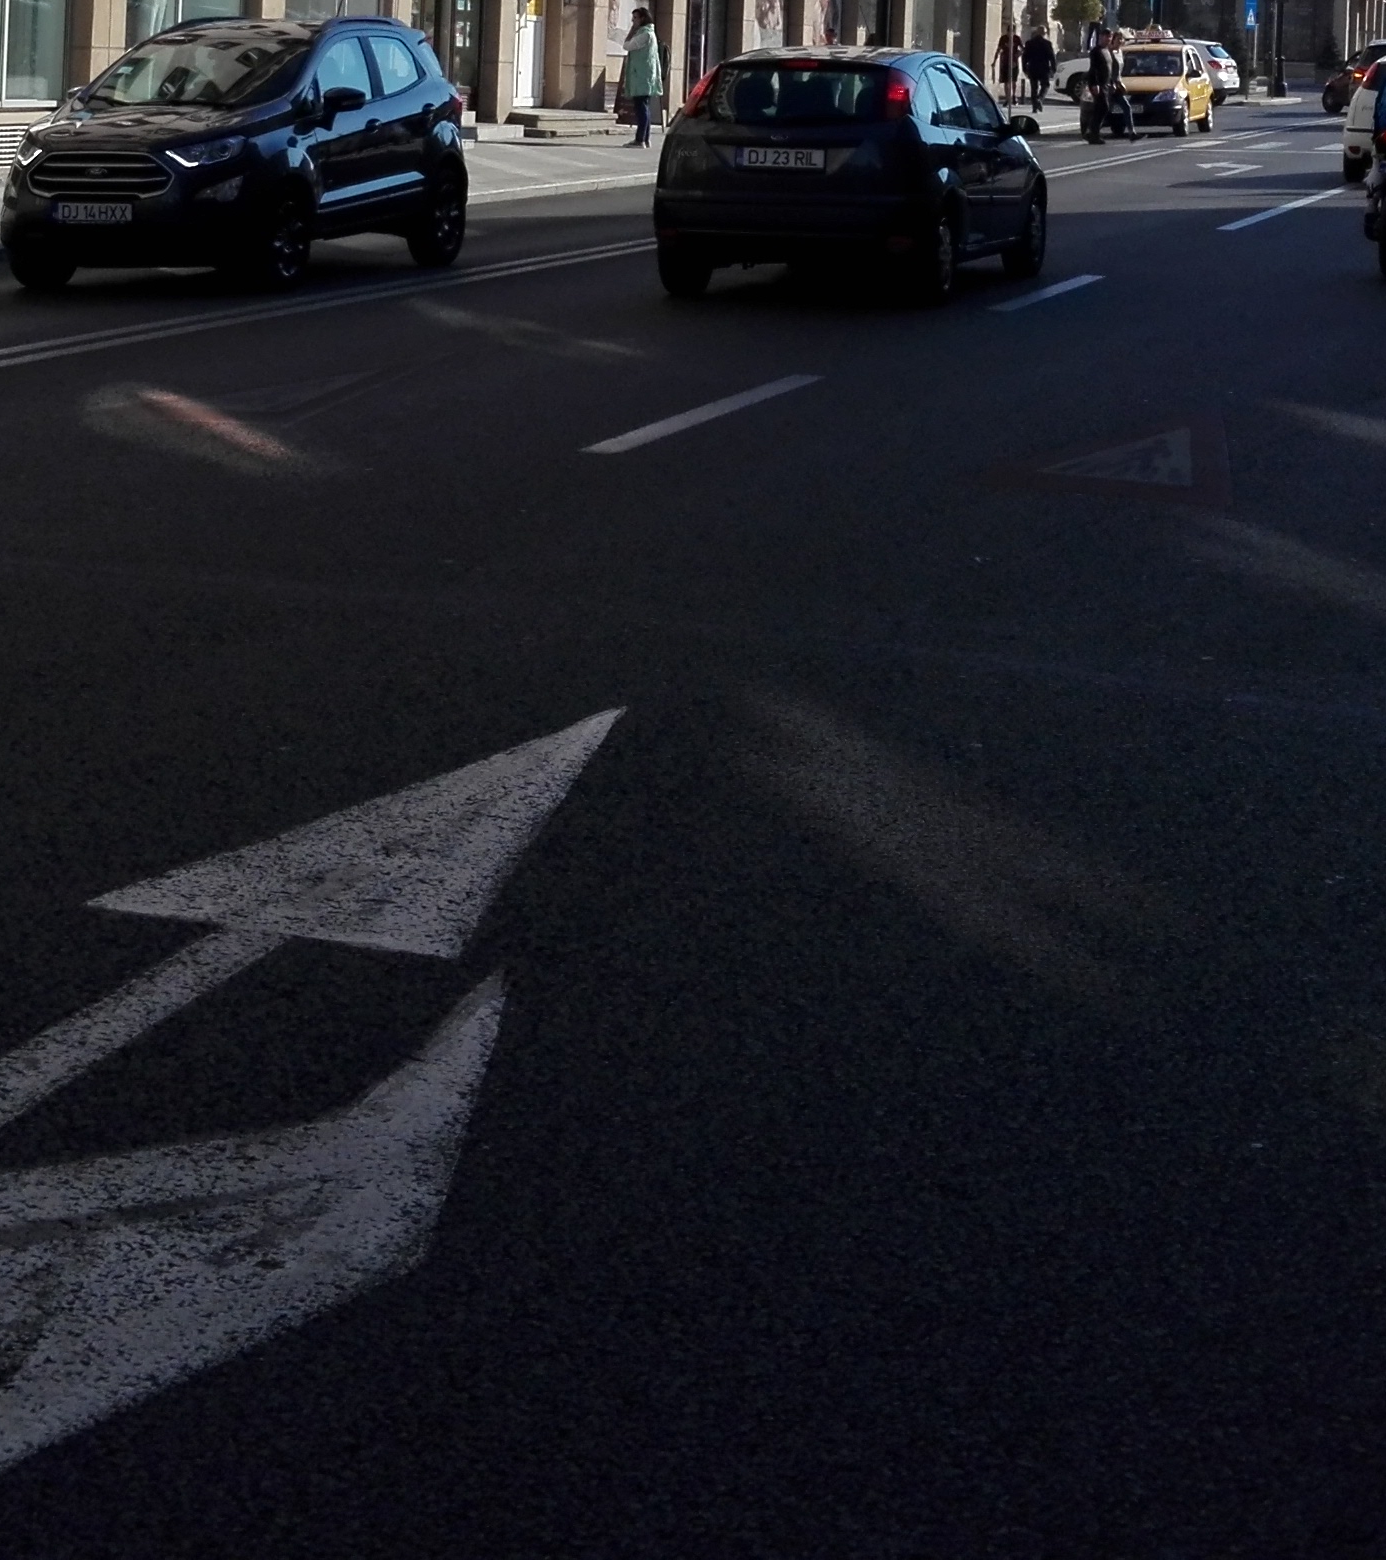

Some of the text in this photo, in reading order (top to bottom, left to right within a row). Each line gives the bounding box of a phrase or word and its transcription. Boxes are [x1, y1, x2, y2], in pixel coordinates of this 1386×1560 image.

[748, 149, 817, 166] DJ 23 RIL
[62, 204, 128, 219] DJ 14 HXX
